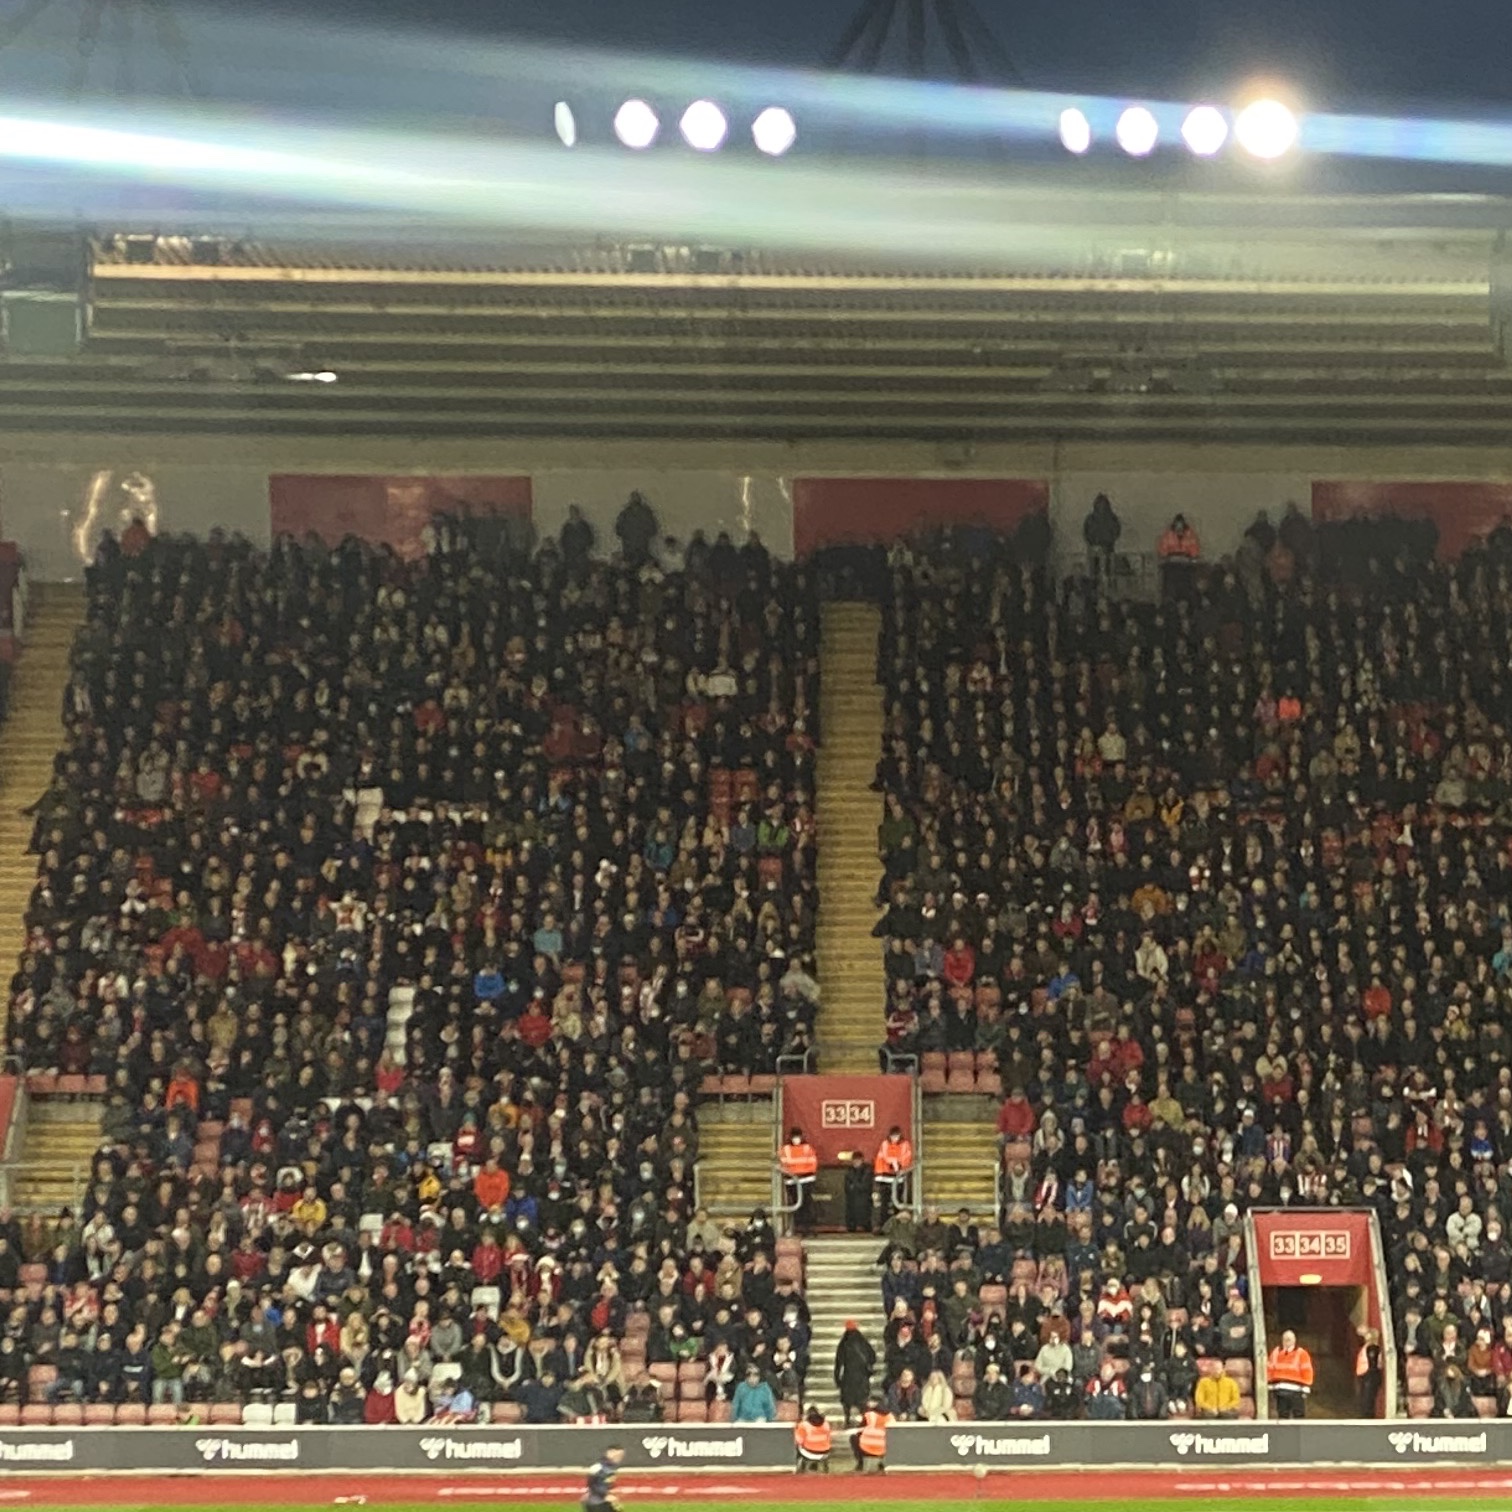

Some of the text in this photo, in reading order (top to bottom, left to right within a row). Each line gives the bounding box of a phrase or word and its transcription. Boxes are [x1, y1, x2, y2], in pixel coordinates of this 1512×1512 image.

[1274, 1236, 1346, 1254] 33 34 35
[222, 1439, 298, 1460] hummel
[446, 1437, 521, 1459] hummel
[668, 1436, 743, 1457] hummel
[976, 1434, 1050, 1455] hummel
[1195, 1433, 1268, 1454] hummel
[1413, 1432, 1487, 1453] hummel
